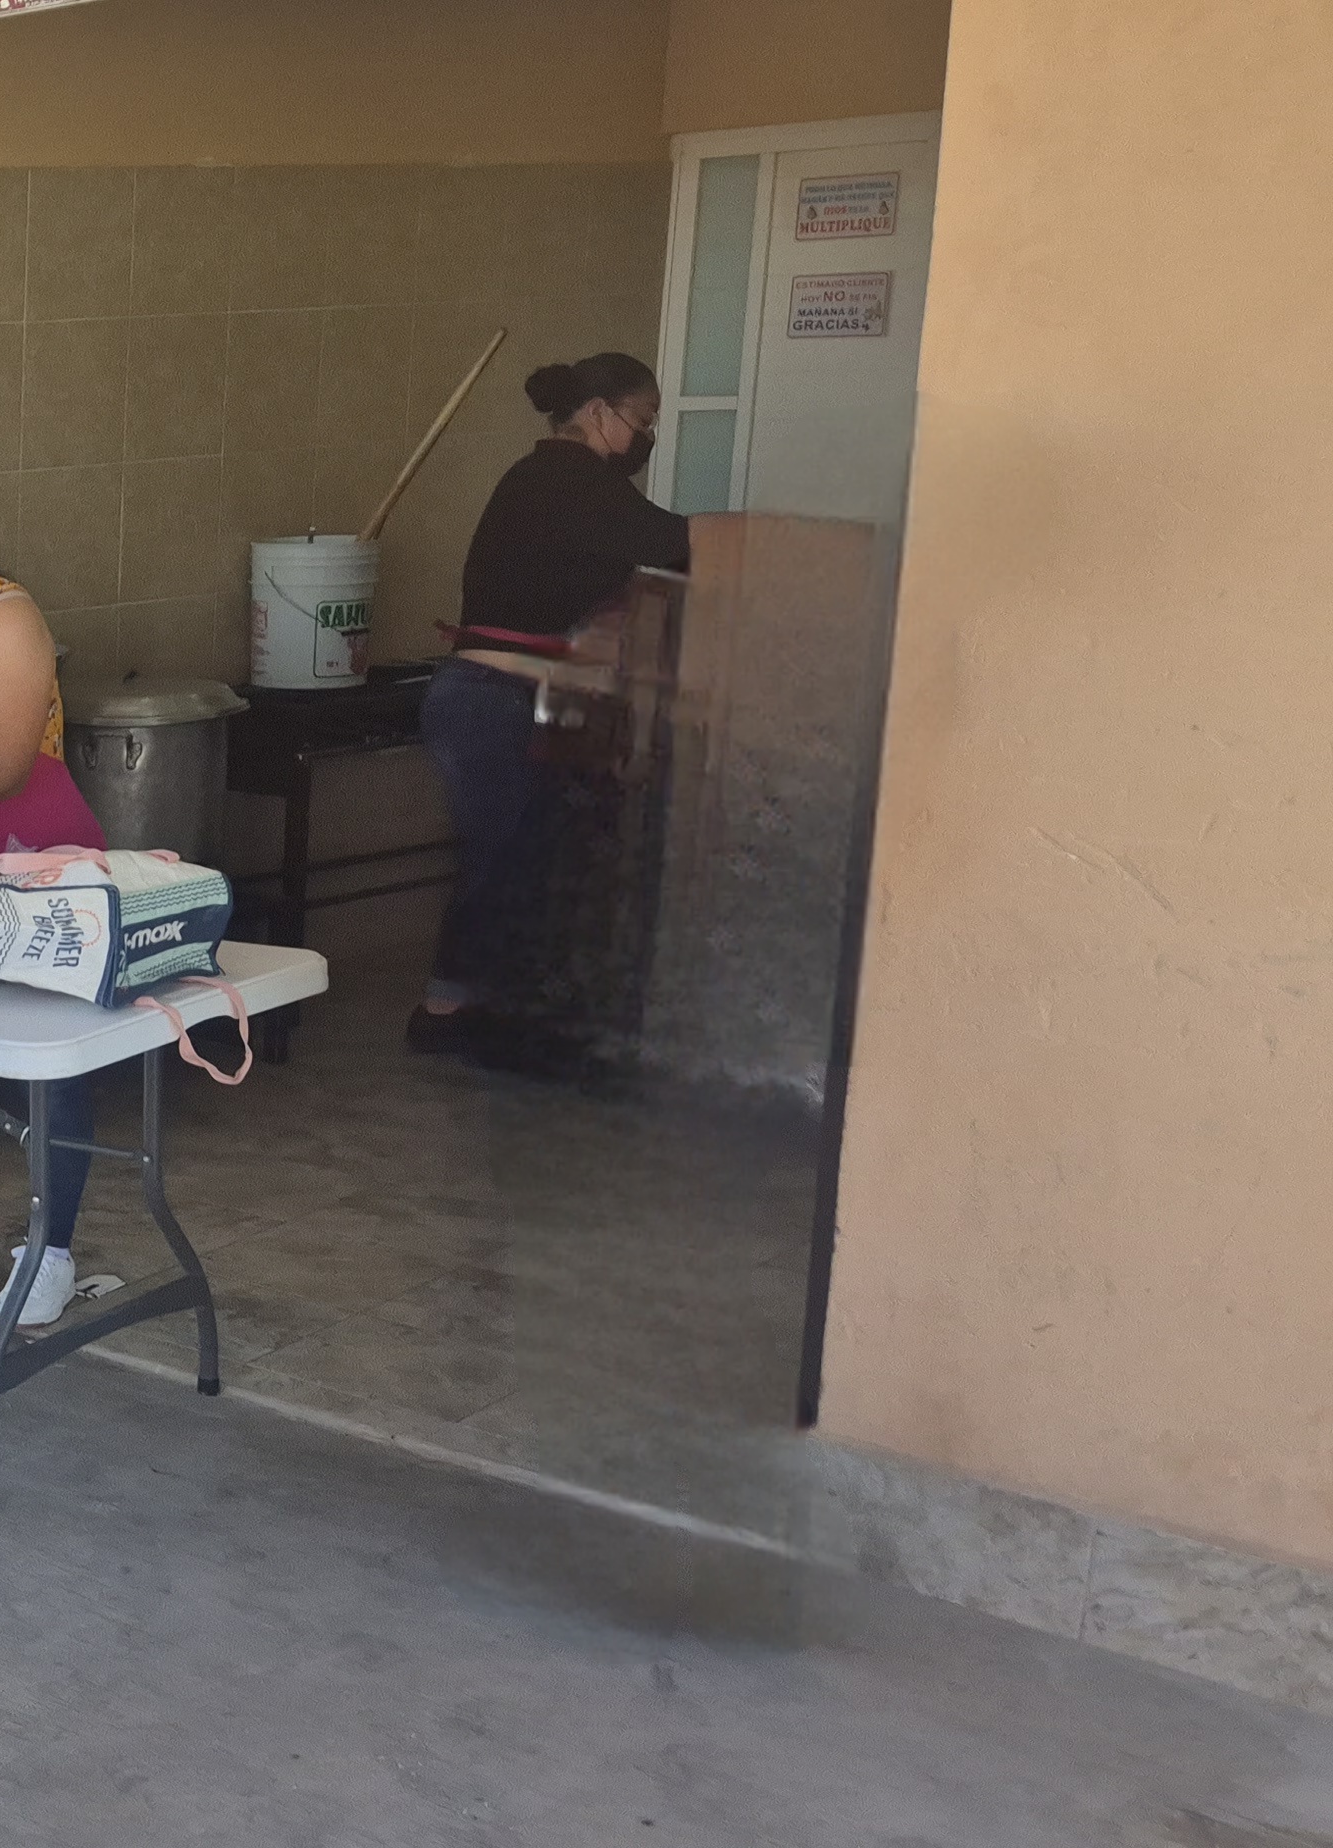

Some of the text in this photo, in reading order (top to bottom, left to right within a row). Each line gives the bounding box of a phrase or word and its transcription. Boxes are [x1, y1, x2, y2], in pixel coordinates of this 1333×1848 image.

[799, 217, 892, 234] MULTIPLIQUE
[823, 290, 845, 302] NO
[797, 306, 845, 318] MAÑANA
[793, 318, 859, 331] GRACIAS
[47, 897, 84, 968] SUMMER
